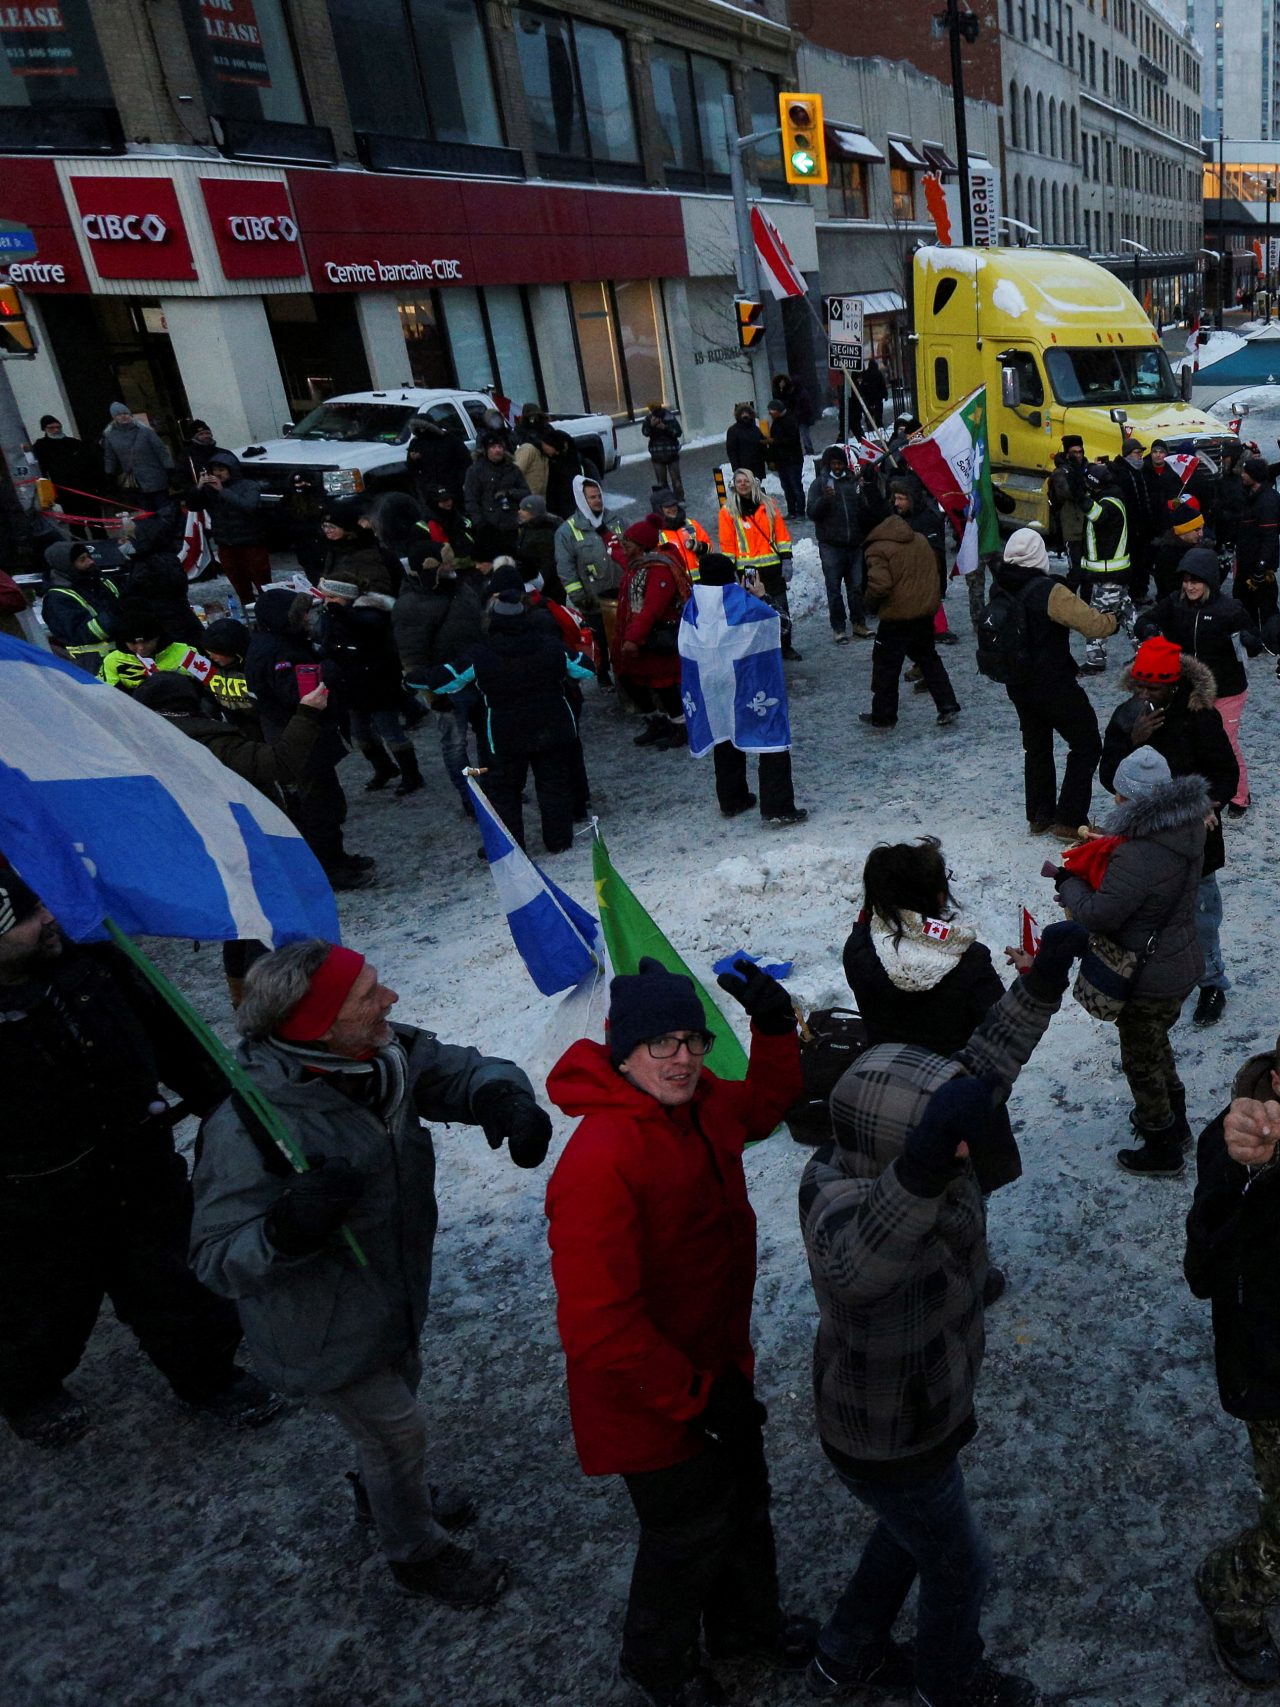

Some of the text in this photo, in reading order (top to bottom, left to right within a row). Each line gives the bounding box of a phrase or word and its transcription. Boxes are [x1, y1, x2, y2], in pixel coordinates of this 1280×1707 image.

[203, 17, 260, 44] LEASE
[82, 214, 141, 240] CIBC
[228, 216, 280, 241] CIBC
[9, 261, 66, 283] entre
[324, 259, 463, 284] Centre bancaire CIBC
[832, 343, 860, 356] BEGINS
[209, 674, 249, 697] FXR
